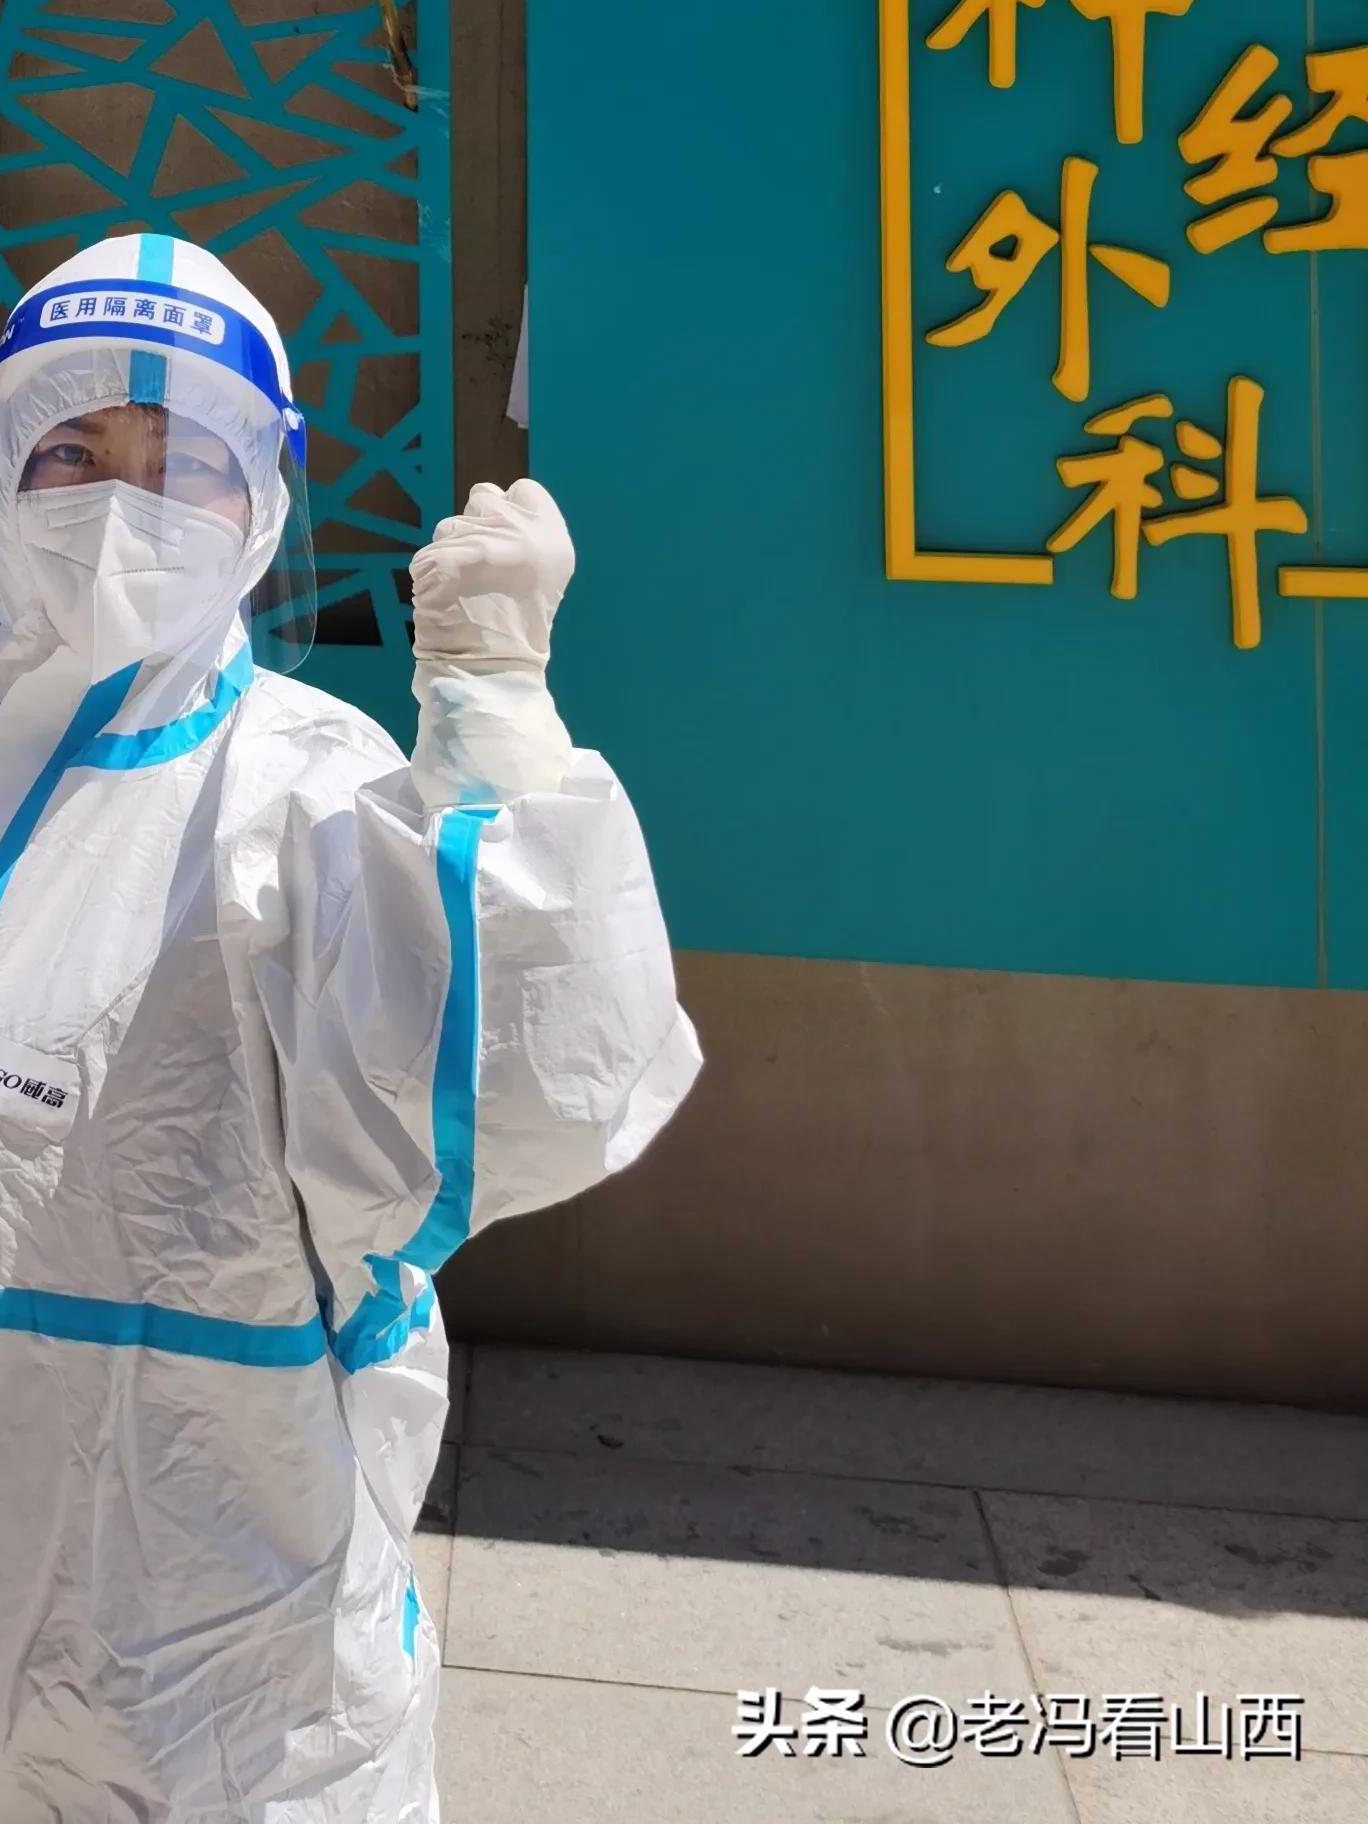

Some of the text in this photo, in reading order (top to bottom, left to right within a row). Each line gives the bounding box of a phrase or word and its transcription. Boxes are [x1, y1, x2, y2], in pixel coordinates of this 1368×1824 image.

[49, 295, 214, 336] 医用隔离面罩
